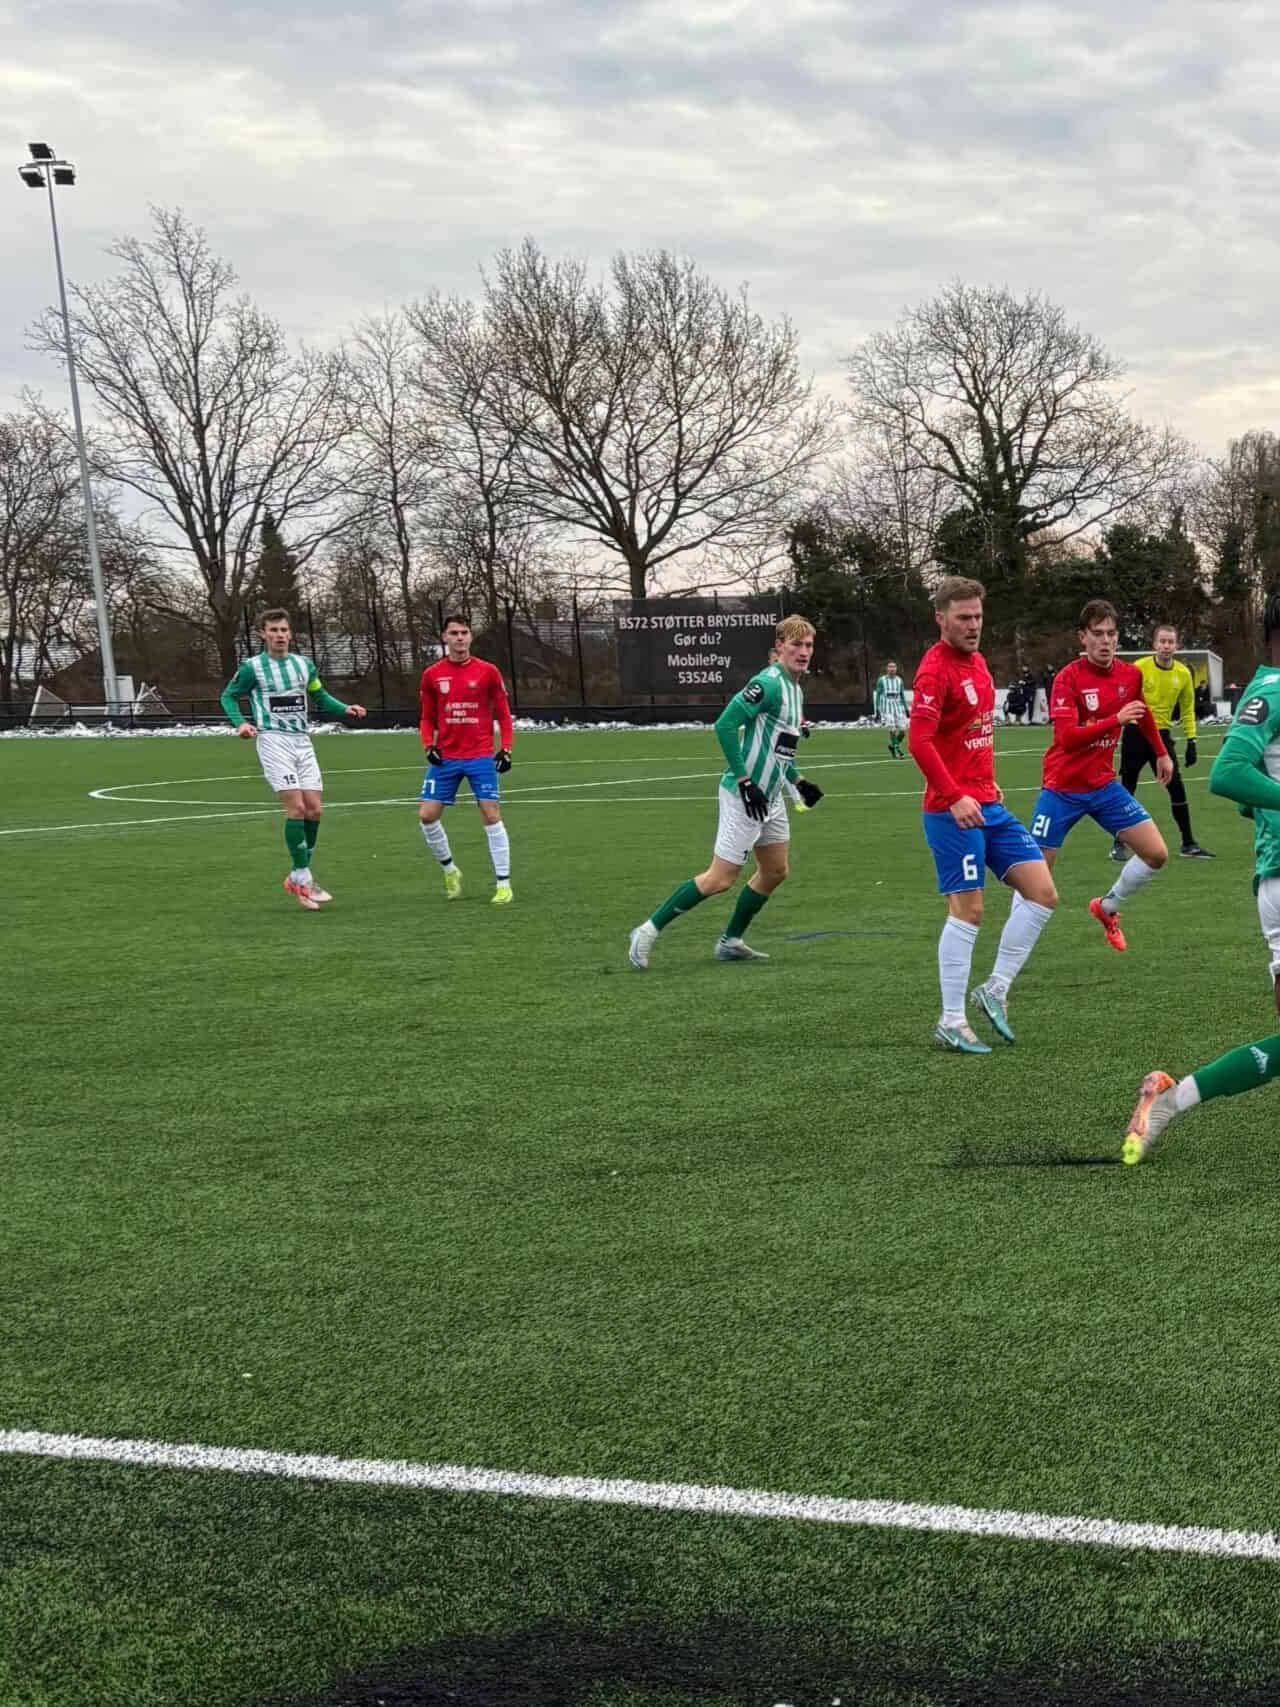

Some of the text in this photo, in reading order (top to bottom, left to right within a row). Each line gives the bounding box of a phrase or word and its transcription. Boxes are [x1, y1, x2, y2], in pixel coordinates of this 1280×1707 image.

[650, 615, 704, 629] STØTTER
[707, 613, 777, 628] BRYSTERNE
[673, 632, 722, 647] Gør du?
[667, 653, 731, 668] MobilePay
[678, 671, 723, 684] 535246
[1032, 815, 1050, 838] 21
[962, 854, 978, 881] 6
